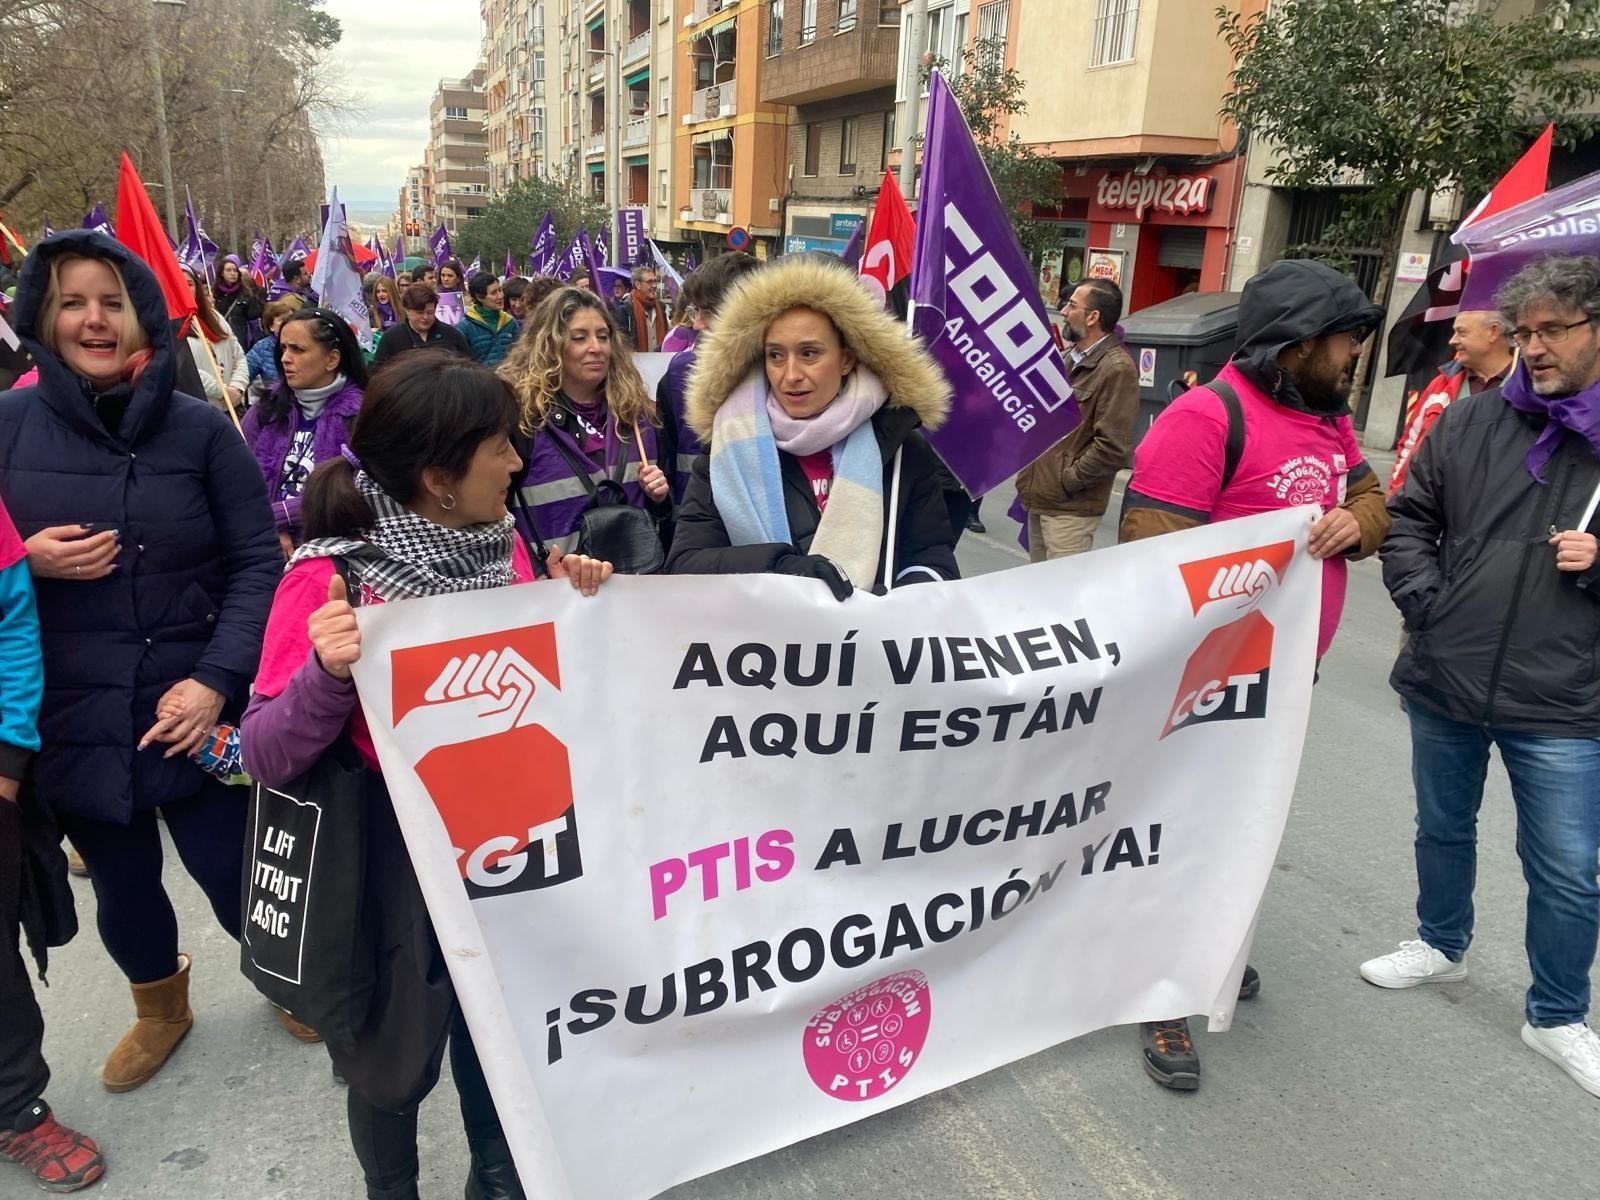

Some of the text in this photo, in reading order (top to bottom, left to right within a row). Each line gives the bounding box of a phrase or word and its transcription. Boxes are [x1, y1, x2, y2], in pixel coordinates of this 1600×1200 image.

[834, 219, 857, 228] antea
[1097, 171, 1208, 220] telepizza
[945, 316, 1037, 433] Andalucía
[673, 617, 1121, 690] AQUÍ VIENEN,
[699, 686, 1103, 763] AQUÍ ESTÁN
[1171, 673, 1260, 726] CGT
[649, 781, 1112, 921] PTIS A LUCHAR
[546, 823, 1162, 1066] ¡SUBROGACIÓN YA!
[816, 981, 922, 1047] SUBROGACIÓN
[830, 1046, 914, 1098] PTIS
